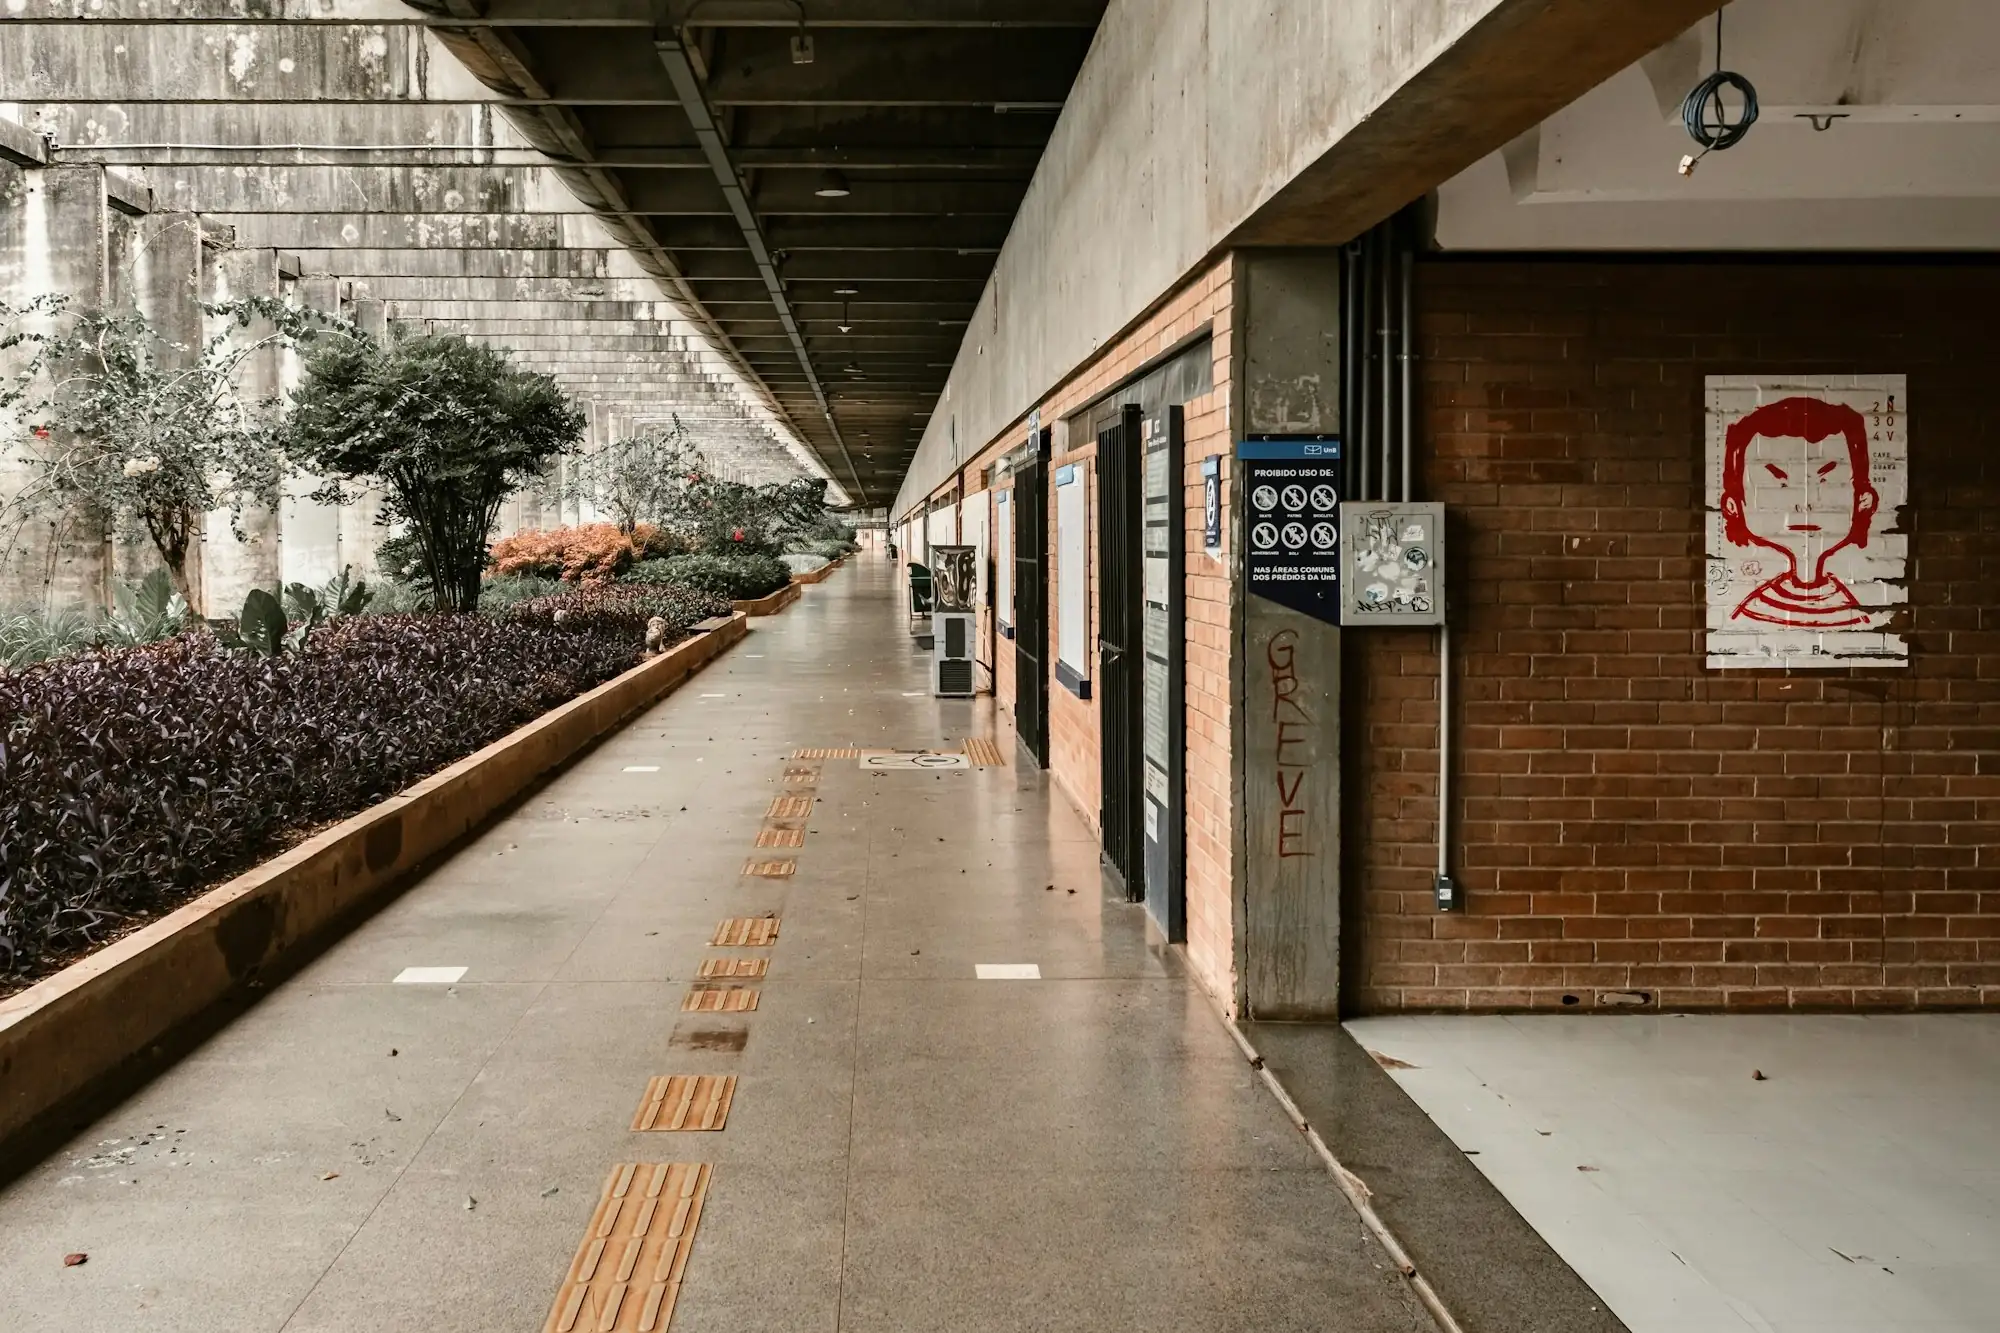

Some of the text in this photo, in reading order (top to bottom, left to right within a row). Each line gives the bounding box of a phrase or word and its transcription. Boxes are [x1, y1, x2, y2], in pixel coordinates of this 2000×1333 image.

[1873, 401, 1880, 412] 2
[1873, 416, 1880, 427] 3
[1873, 431, 1880, 441] 4
[1272, 565, 1298, 573] ÁREAS
[1272, 573, 1306, 581] PRÉDIOS
[1267, 629, 1315, 858] GREVE
